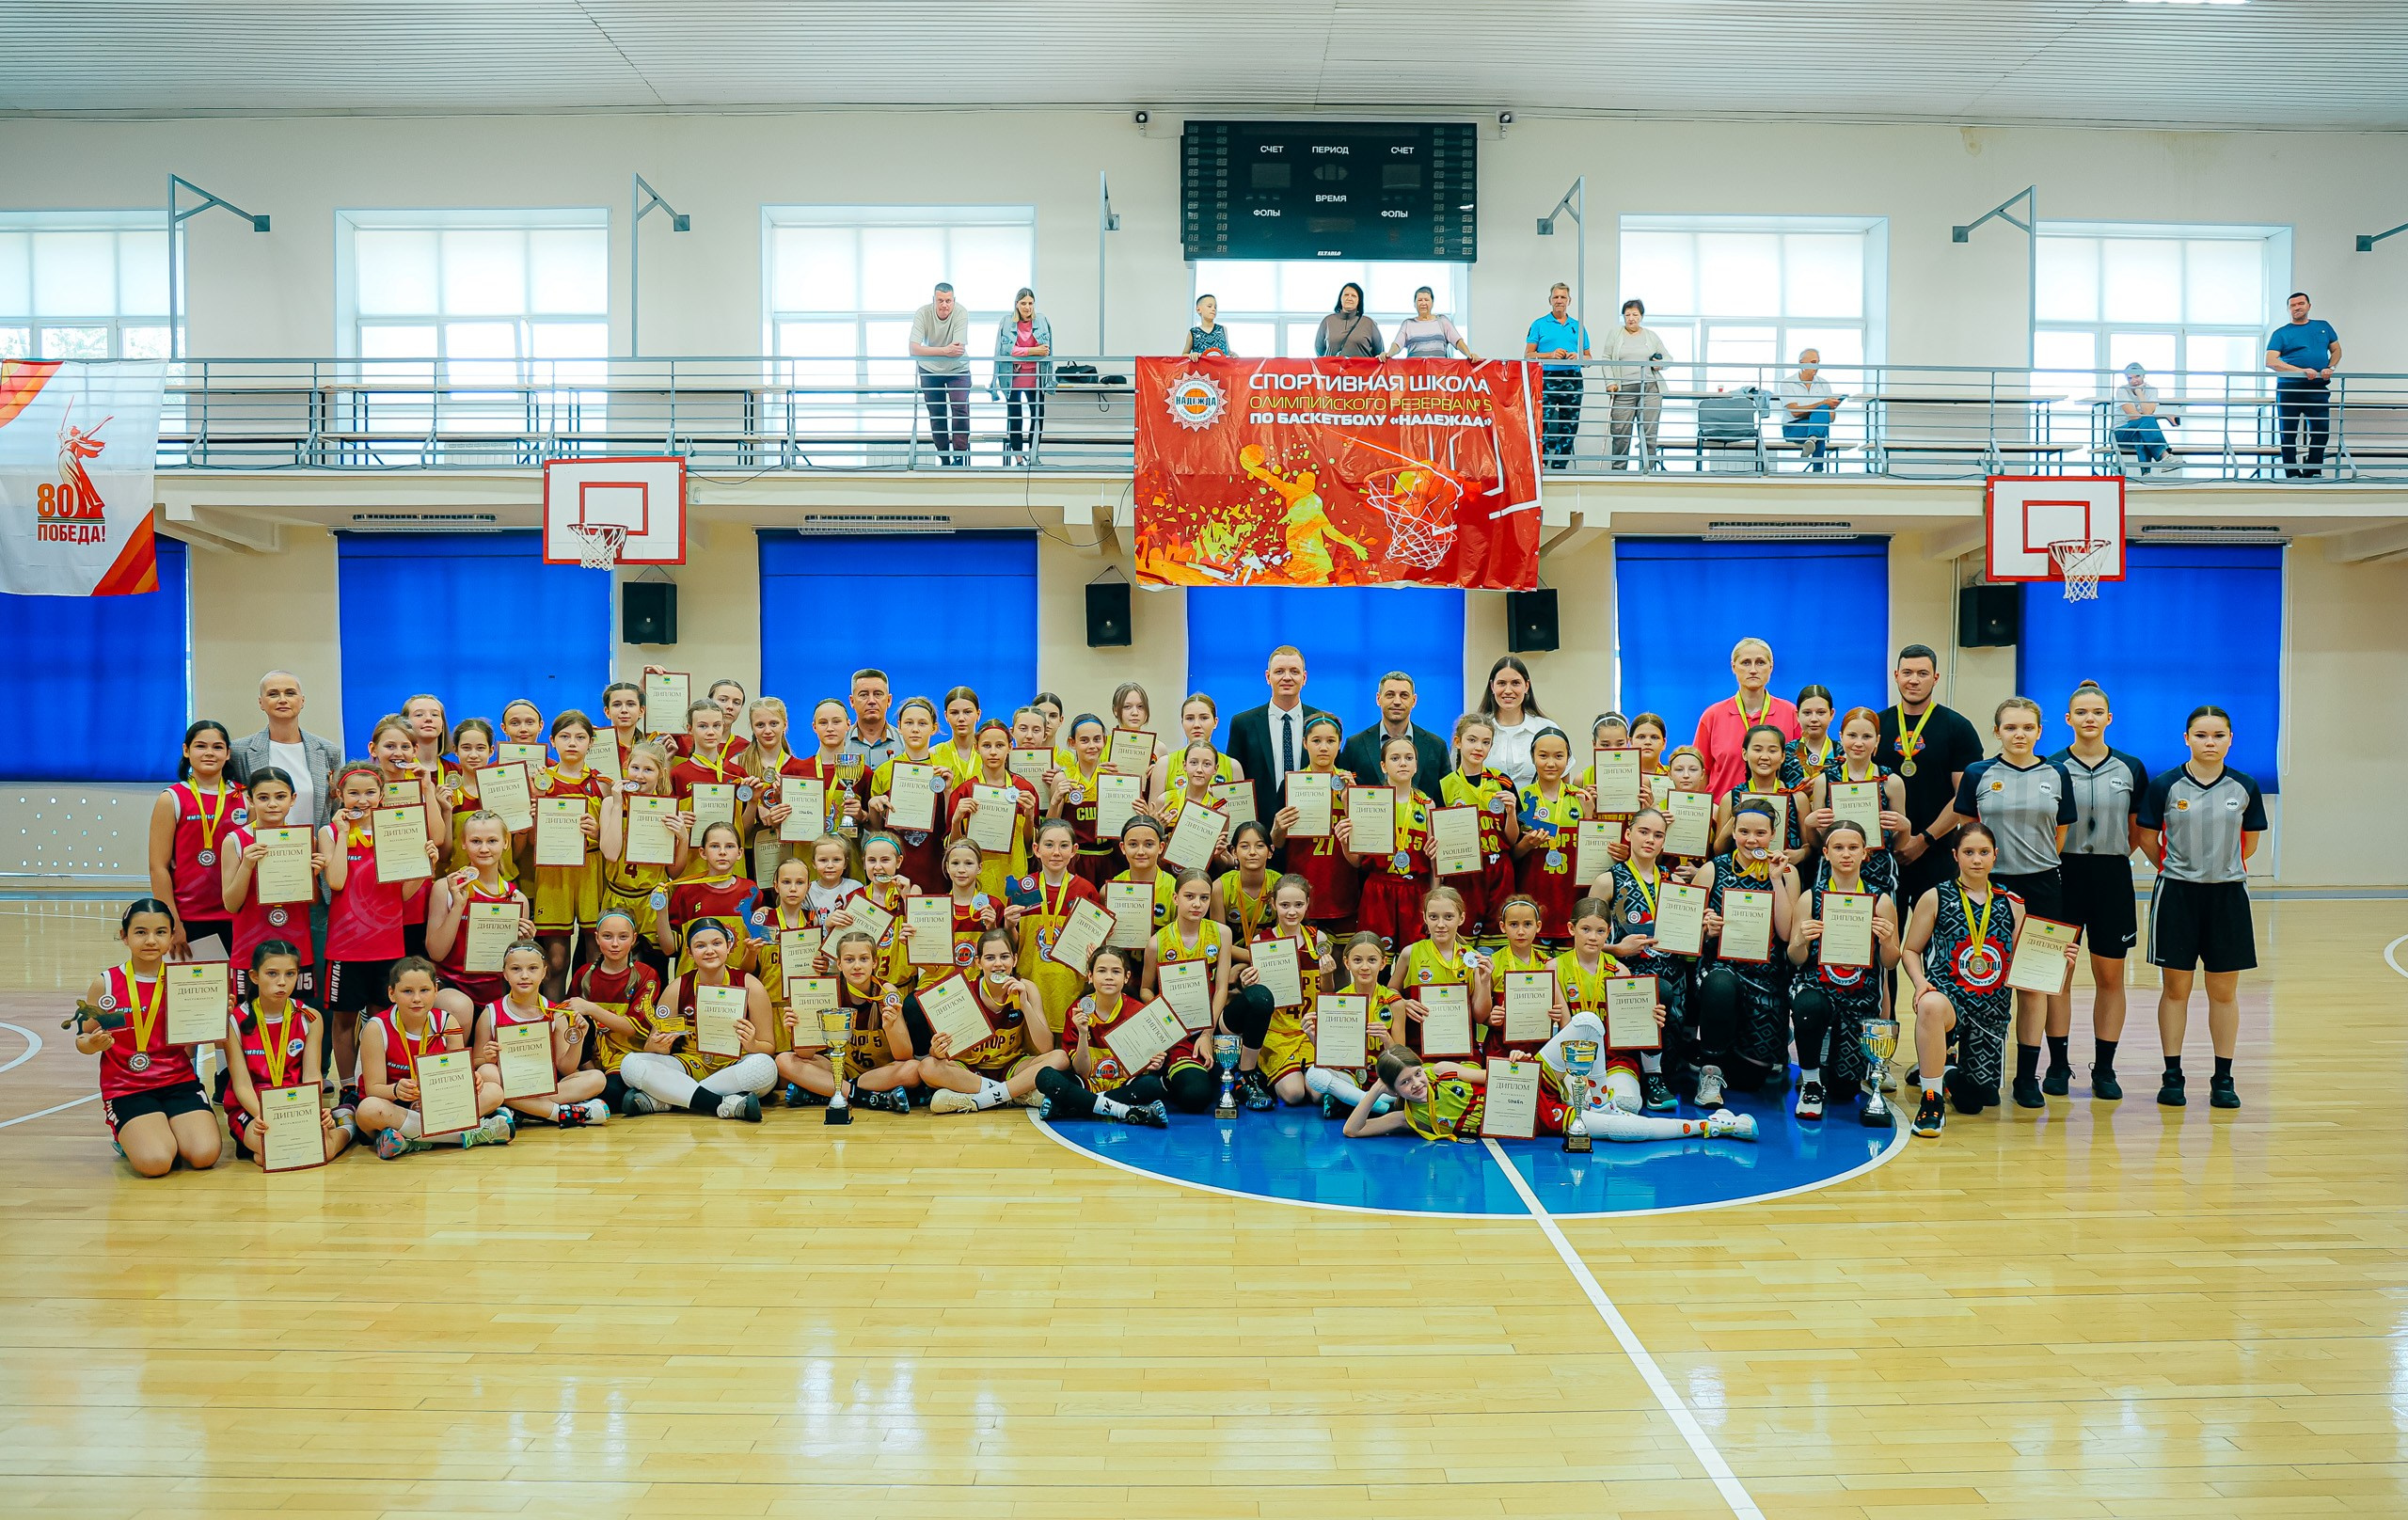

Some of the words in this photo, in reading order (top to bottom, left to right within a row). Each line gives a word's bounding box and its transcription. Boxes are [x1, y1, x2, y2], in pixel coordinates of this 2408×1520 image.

[1312, 146, 1349, 155] ПЕРИОД
[1253, 209, 1280, 217] ФОЛЫ
[1381, 210, 1408, 218] ФОЛЫ
[1249, 373, 1404, 392] СПОРТИВНАЯ
[1410, 374, 1491, 395] ШКОЛА
[1249, 395, 1386, 411] ОЛИМПИЙСКОГО
[1390, 397, 1463, 412] РЕЗЕРВА
[1249, 412, 1275, 424] ПО
[1277, 412, 1386, 426] БАСКЕТБОЛУ
[1390, 414, 1493, 427] «НАДЕЖДА»
[37, 483, 74, 517] 80
[38, 525, 106, 545] ПОБЕДА!
[488, 784, 520, 794] ДИПЛОМ
[979, 804, 1008, 812] ДИПЛОМ
[383, 828, 418, 837] ДИПЛОМ
[1185, 821, 1213, 835] ДИПЛОМ
[1313, 835, 1335, 855] 27
[1413, 836, 1422, 850] 5
[624, 864, 638, 879] 4
[1666, 903, 1696, 912] ДИПЛОМ
[1078, 919, 1101, 936] ДИПЛОМ
[2028, 939, 2062, 951] ДИПЛОМ
[1261, 959, 1290, 968] ДИПЛОМ
[297, 973, 313, 990] 15
[1170, 982, 1200, 991] ДИПЛОМ
[178, 986, 218, 995] ДИПЛОМ
[935, 996, 965, 1016] ДИПЛОМ
[1145, 1016, 1166, 1043] ДИПЛОМ
[873, 1032, 883, 1048] 5
[1009, 1033, 1016, 1045] 5
[508, 1044, 542, 1053] ДИПЛОМ
[429, 1075, 464, 1085] ДИПЛОМ
[273, 1109, 312, 1120] ДИПЛОМ
